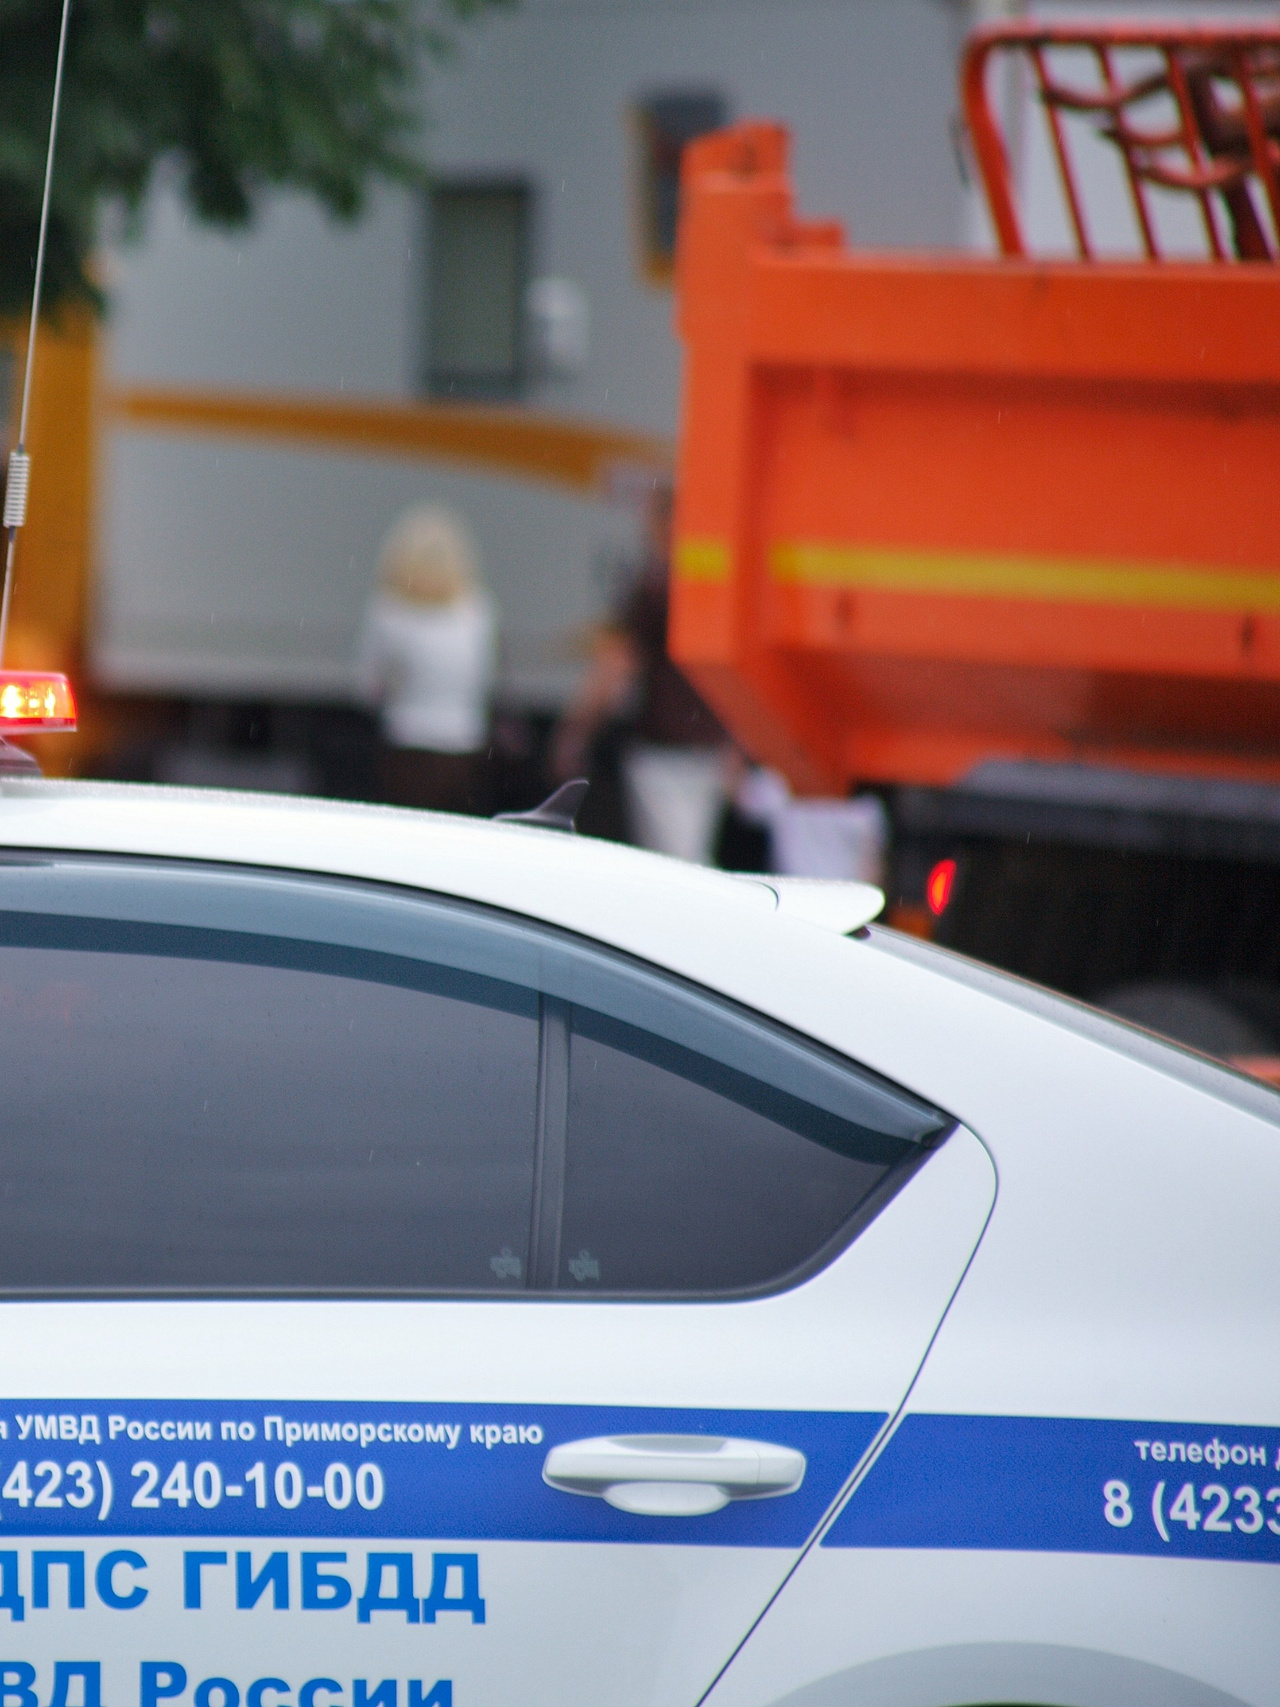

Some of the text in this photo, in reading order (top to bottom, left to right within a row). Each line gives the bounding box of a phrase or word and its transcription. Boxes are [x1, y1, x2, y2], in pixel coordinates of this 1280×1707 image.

[15, 1414, 102, 1445] УМВД
[107, 1415, 213, 1441] России
[220, 1420, 257, 1441] по
[263, 1415, 462, 1450] Приморскому
[469, 1423, 544, 1450] краю
[1133, 1437, 1267, 1470] телефон
[131, 1460, 384, 1510] 240-10-00
[1103, 1479, 1133, 1528] 8
[183, 1550, 486, 1625] ГИБДД
[140, 1660, 453, 1707] России
